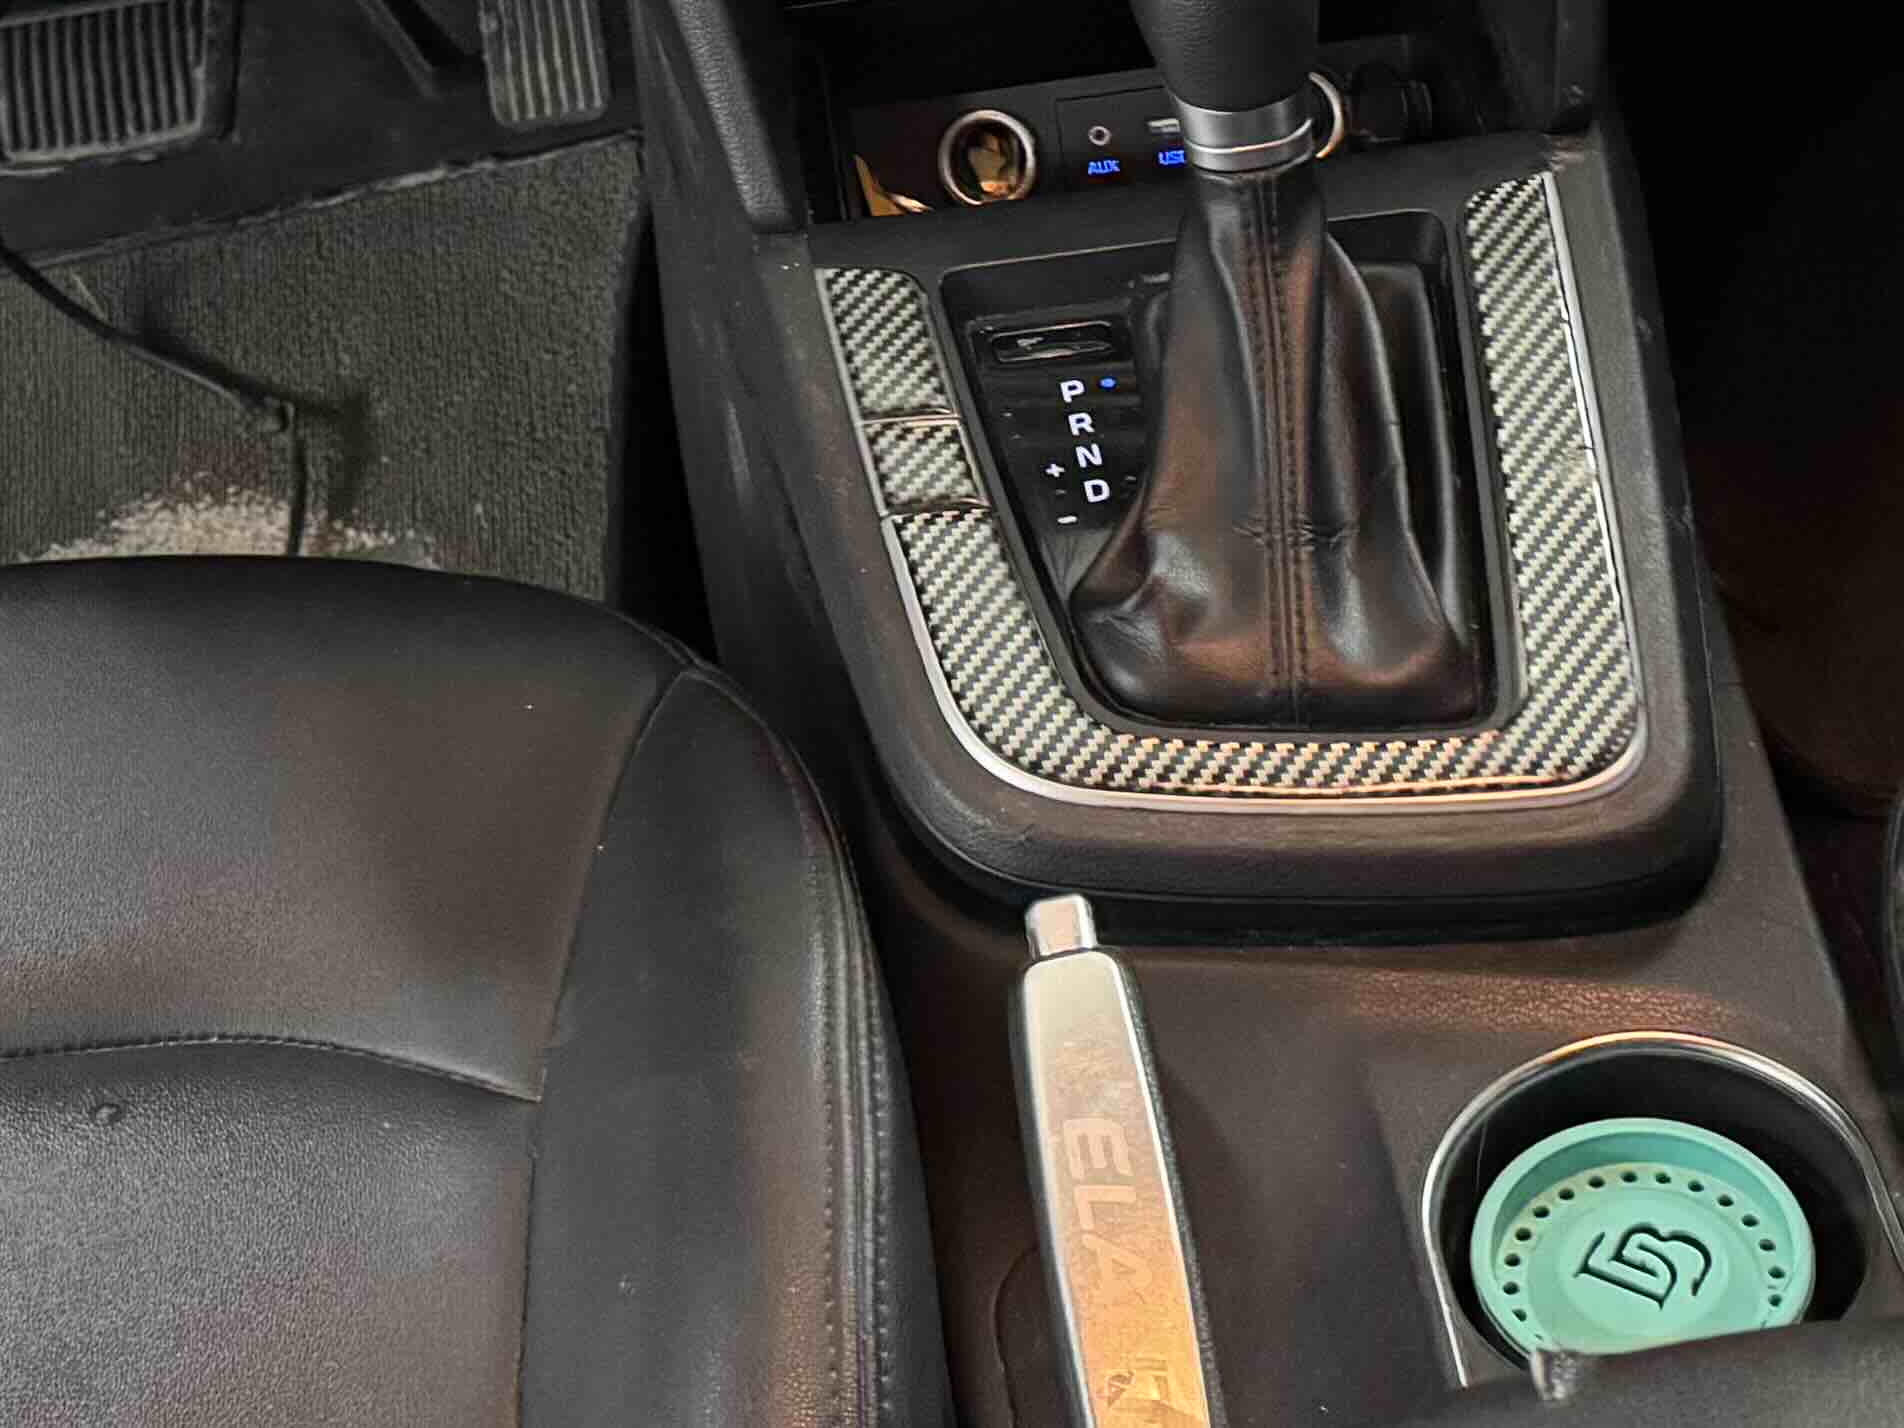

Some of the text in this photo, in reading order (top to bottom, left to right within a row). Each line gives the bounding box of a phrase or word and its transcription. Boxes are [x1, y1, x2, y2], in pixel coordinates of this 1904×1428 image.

[1087, 159, 1122, 177] AUX
[1060, 379, 1086, 405] P
[1068, 412, 1095, 437] R
[1075, 444, 1103, 470] N
[1084, 478, 1111, 504] D
